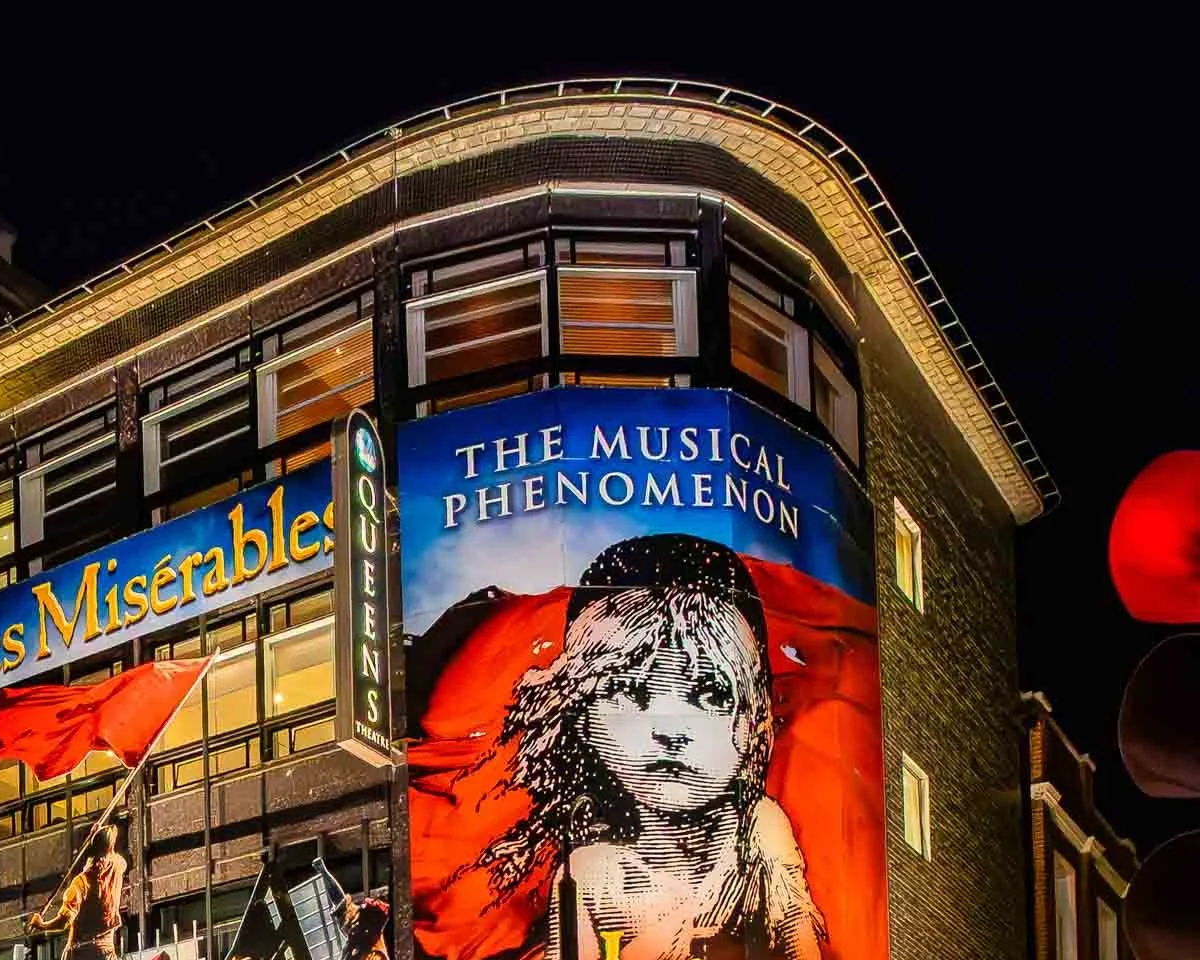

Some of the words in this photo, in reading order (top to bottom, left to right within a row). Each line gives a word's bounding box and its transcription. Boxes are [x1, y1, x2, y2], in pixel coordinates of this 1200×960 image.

[455, 424, 564, 479] THE
[590, 426, 791, 493] MUSICAL
[443, 471, 798, 539] PHENOMENON
[359, 476, 380, 723] QUEENS
[356, 720, 390, 750] THEATRE
